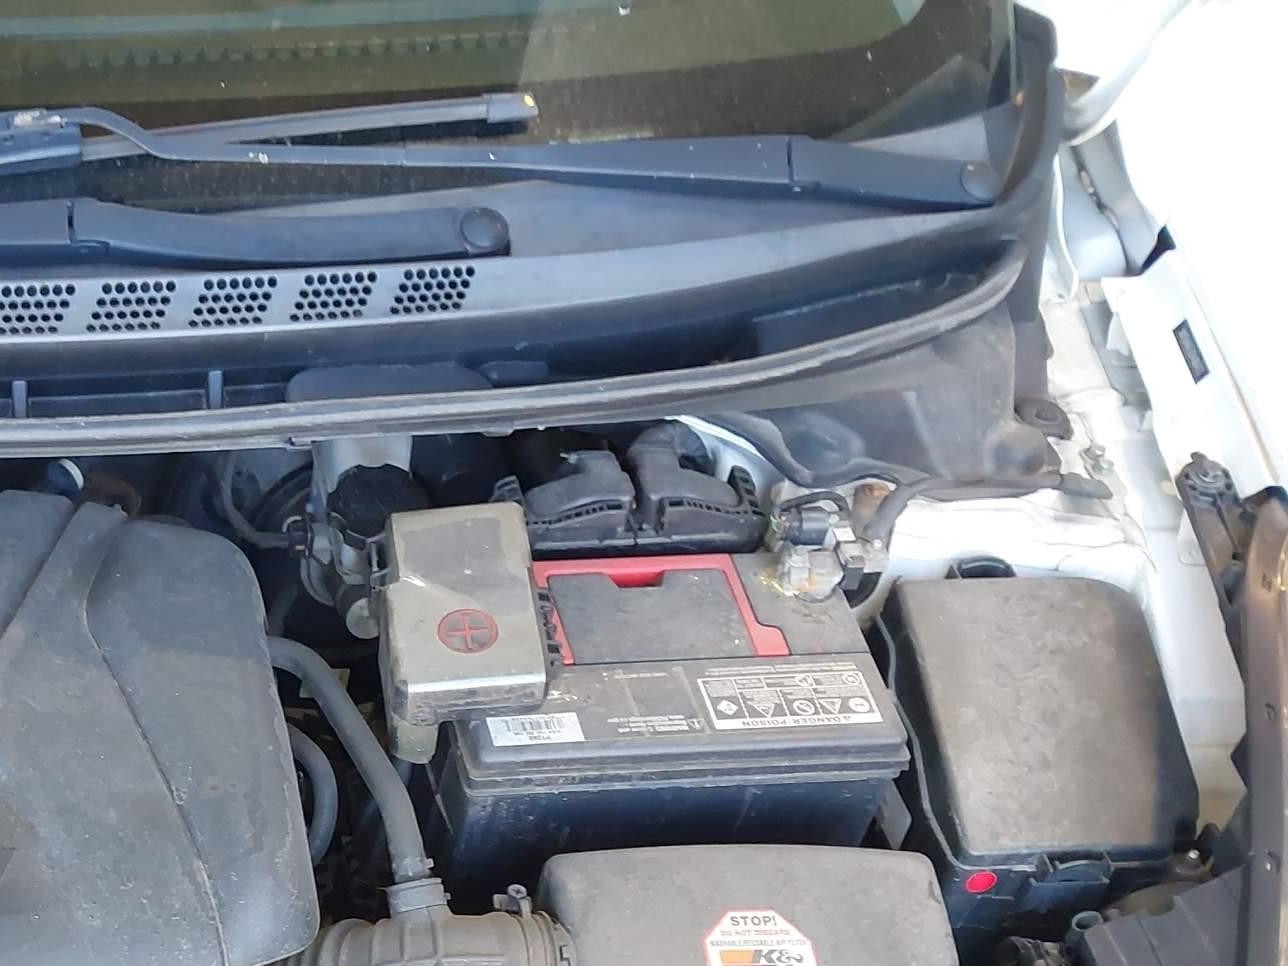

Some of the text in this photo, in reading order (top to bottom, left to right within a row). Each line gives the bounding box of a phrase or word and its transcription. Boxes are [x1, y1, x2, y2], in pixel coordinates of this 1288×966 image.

[741, 715, 841, 728] DANGER POISON
[729, 915, 778, 927] STOP!
[719, 929, 734, 937] DO
[734, 929, 752, 937] NOT
